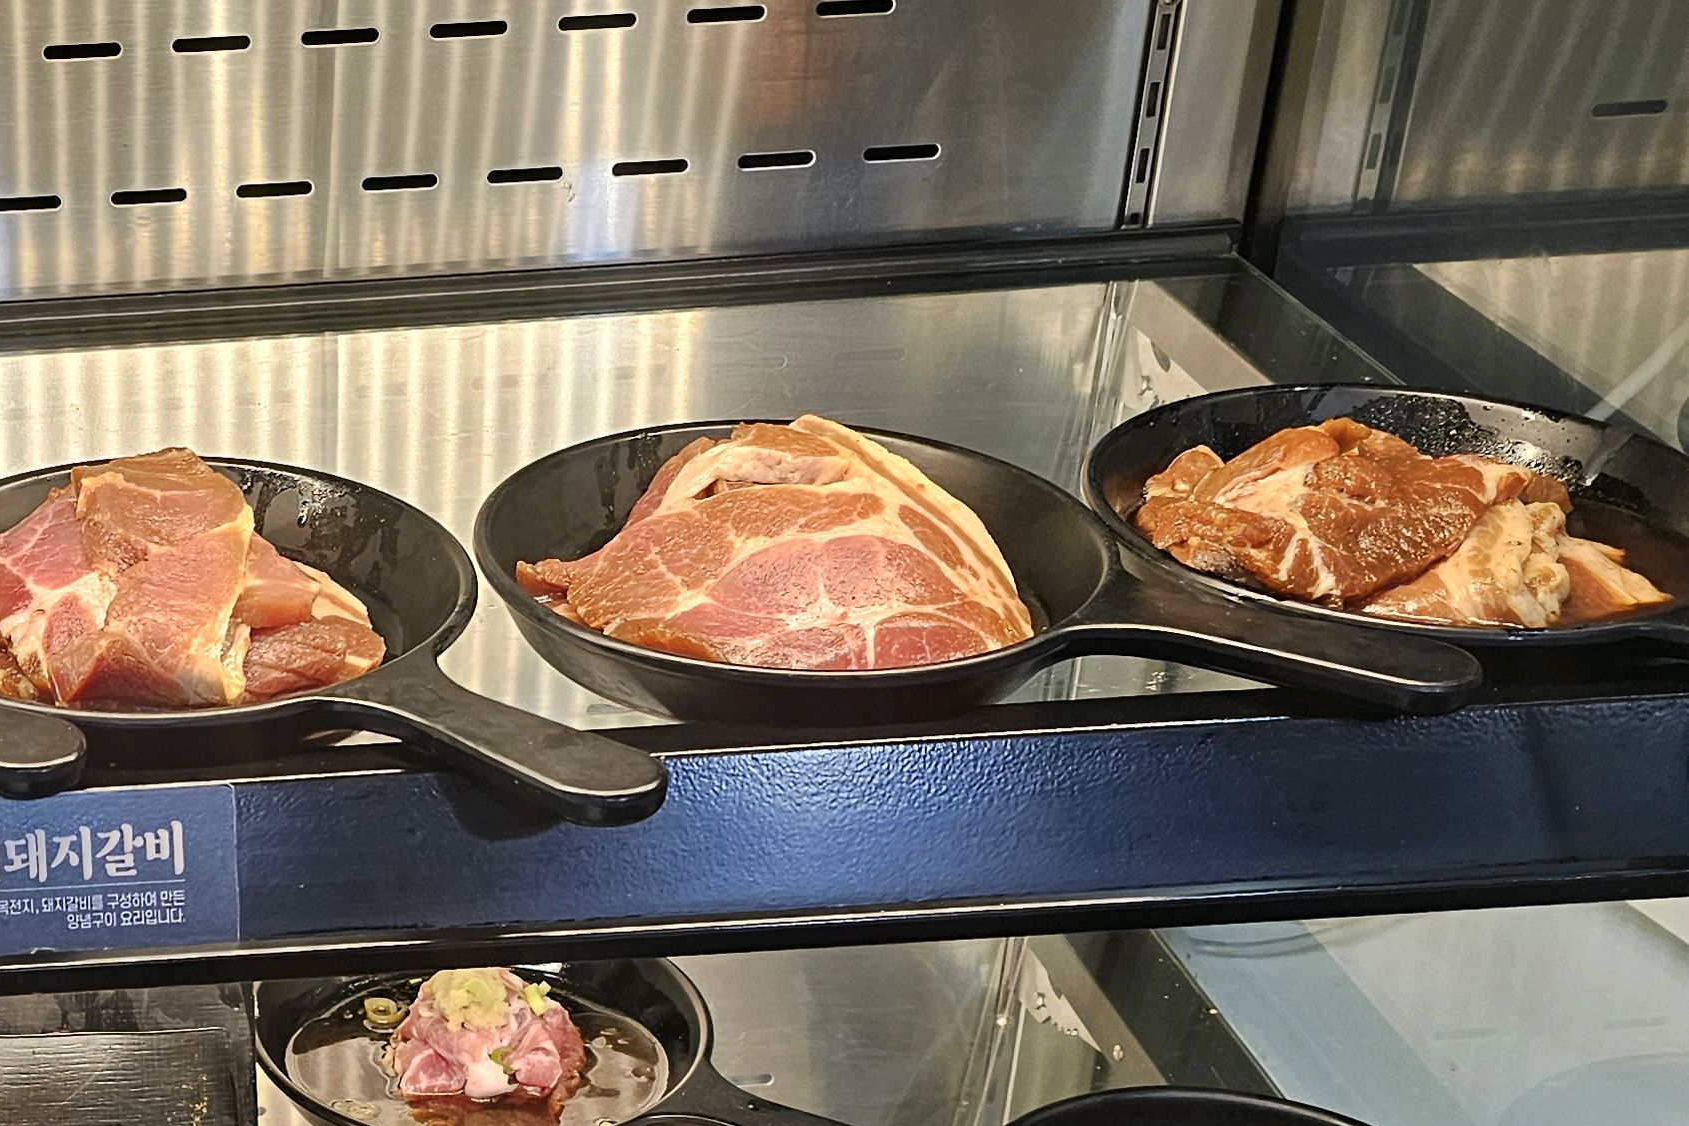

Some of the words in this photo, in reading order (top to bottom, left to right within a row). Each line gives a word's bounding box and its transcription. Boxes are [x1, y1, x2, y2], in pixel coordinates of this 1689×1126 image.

[42, 894, 103, 913] 돼지갈비를
[107, 891, 157, 909] 구성하여
[160, 890, 185, 907] 만든
[67, 912, 116, 930] 양념구이
[120, 908, 186, 927] 요리입니다.
